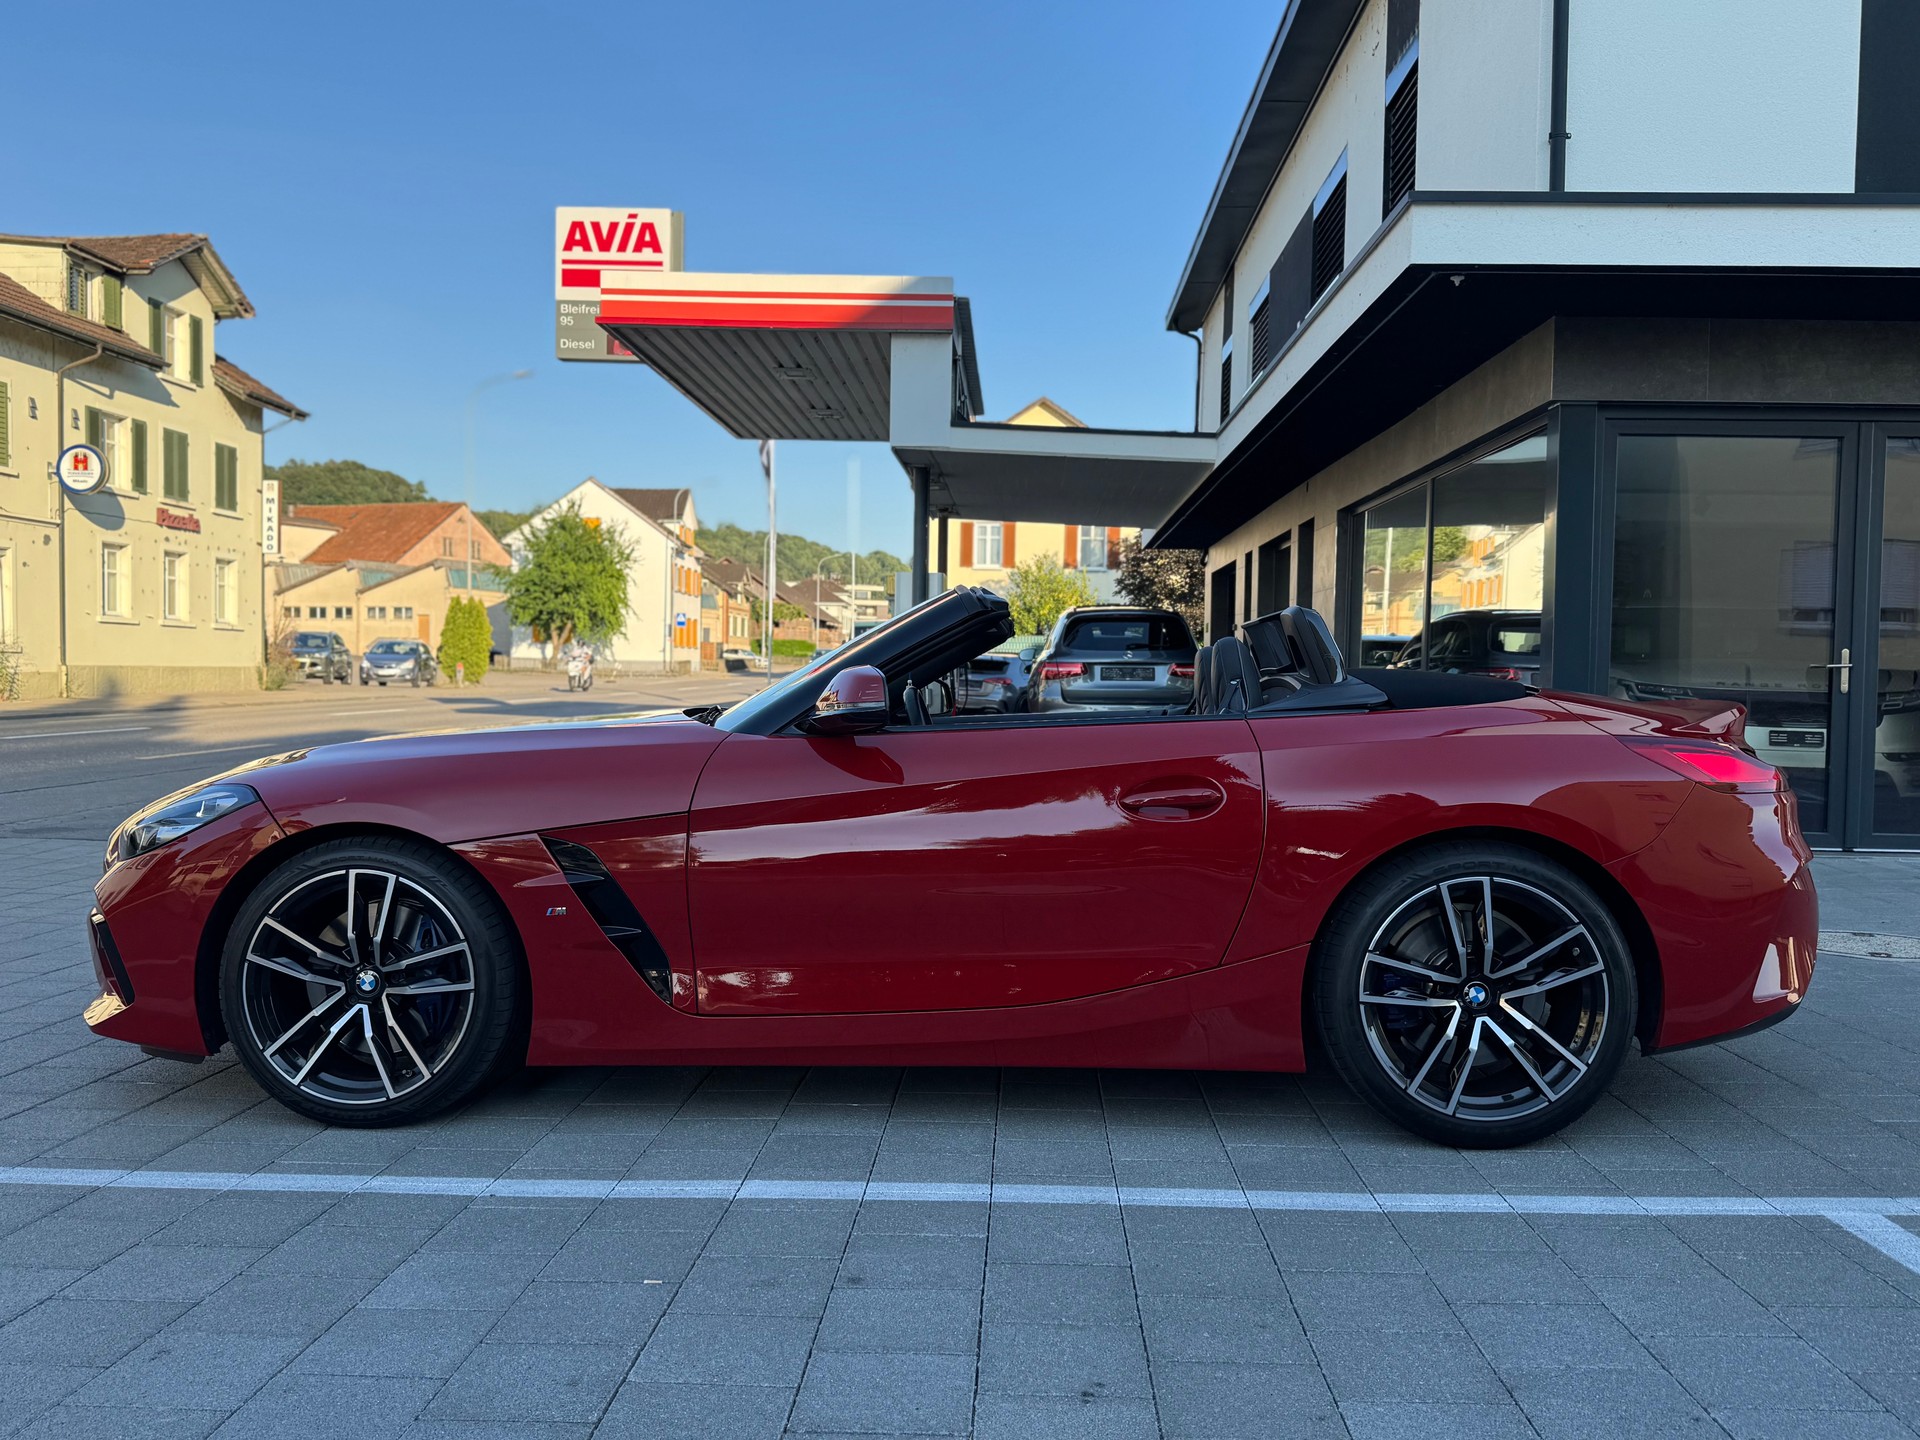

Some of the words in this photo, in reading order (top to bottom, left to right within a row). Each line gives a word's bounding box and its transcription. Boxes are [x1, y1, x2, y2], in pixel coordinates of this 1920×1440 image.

[560, 304, 600, 314] Bleifrei
[560, 316, 574, 326] 95
[560, 339, 595, 349] Diesel
[266, 497, 275, 551] MIKADO
[1433, 861, 1506, 874] SPORT
